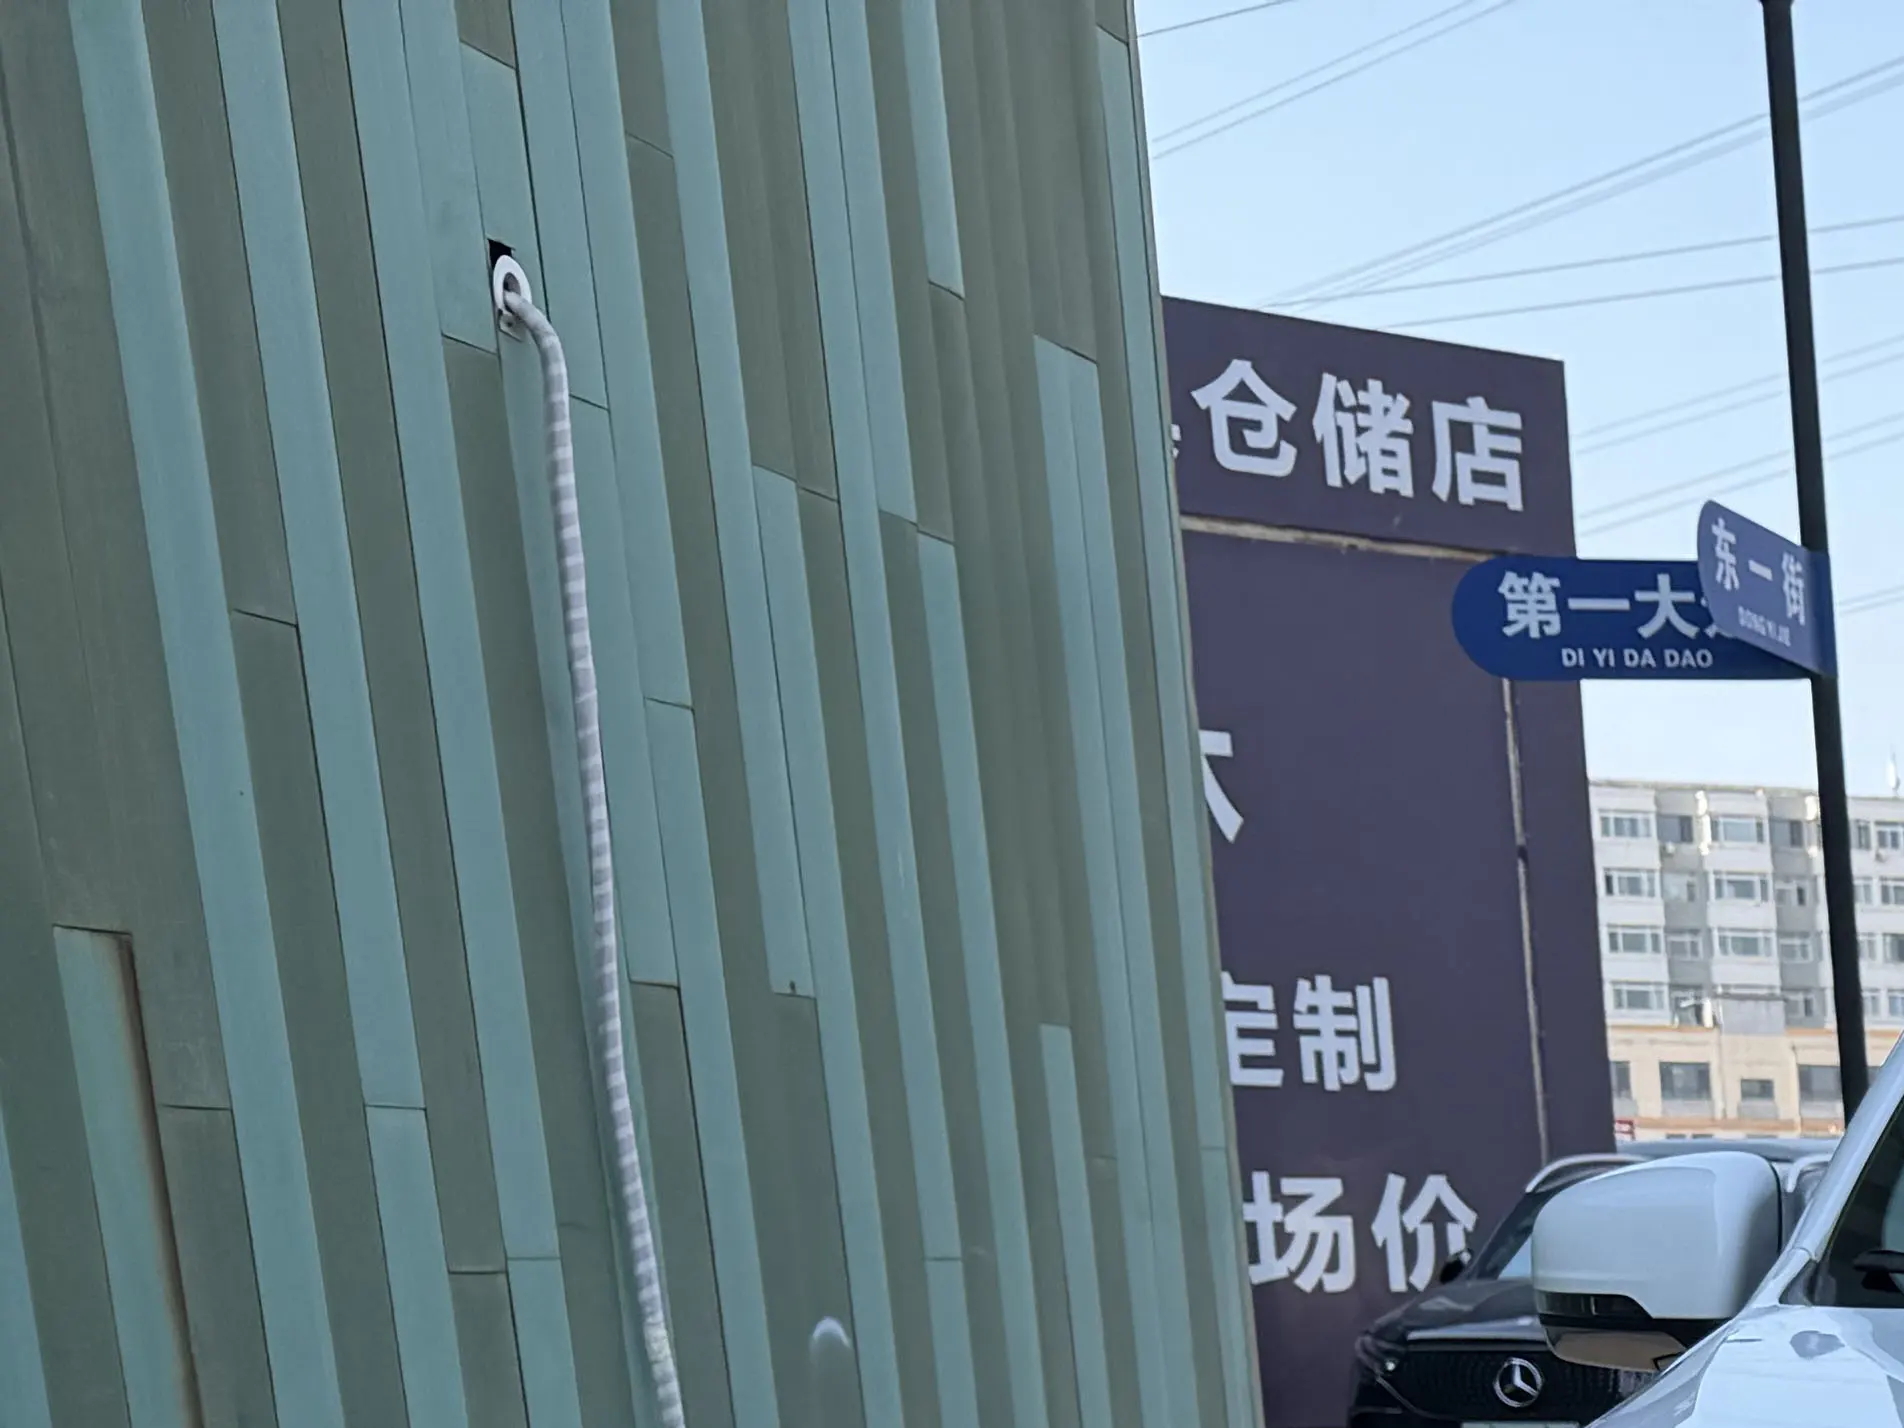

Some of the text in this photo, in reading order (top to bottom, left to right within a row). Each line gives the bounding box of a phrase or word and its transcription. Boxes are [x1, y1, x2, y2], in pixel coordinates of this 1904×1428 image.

[1170, 359, 1524, 511] 仓储店
[1498, 571, 1736, 640] 第一大
[1711, 517, 1807, 627] 东一街
[1562, 648, 1714, 669] DI YI DA DAO
[1243, 1171, 1478, 1294] 场价
